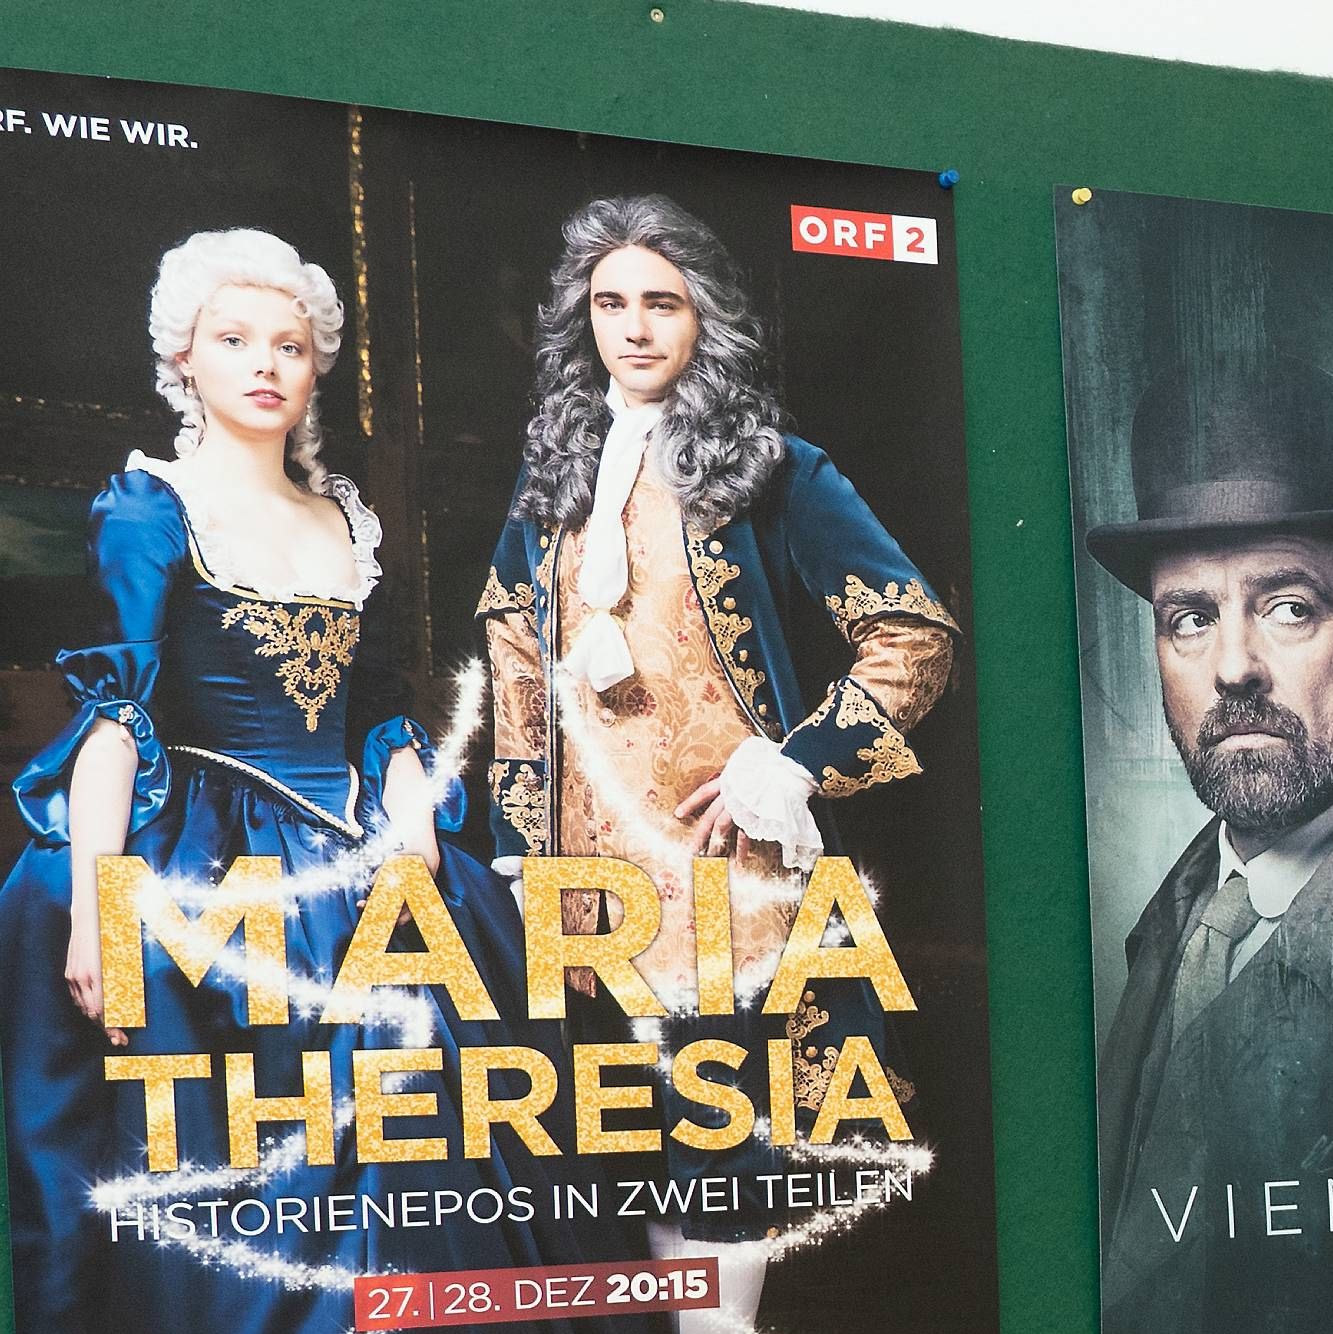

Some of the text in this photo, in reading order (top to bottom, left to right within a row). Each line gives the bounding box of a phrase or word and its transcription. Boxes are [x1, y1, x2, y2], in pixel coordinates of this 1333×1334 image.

[42, 112, 111, 141] WIE
[119, 119, 199, 149] WIR.
[799, 215, 926, 253] ORF 2
[95, 854, 918, 1029] MARIA
[104, 1036, 916, 1174] THERESIA
[110, 1169, 915, 1243] HISTORIENEPOS IN ZWEI TEILEN
[368, 1268, 709, 1320] 27. 28. DEZ 20:15
